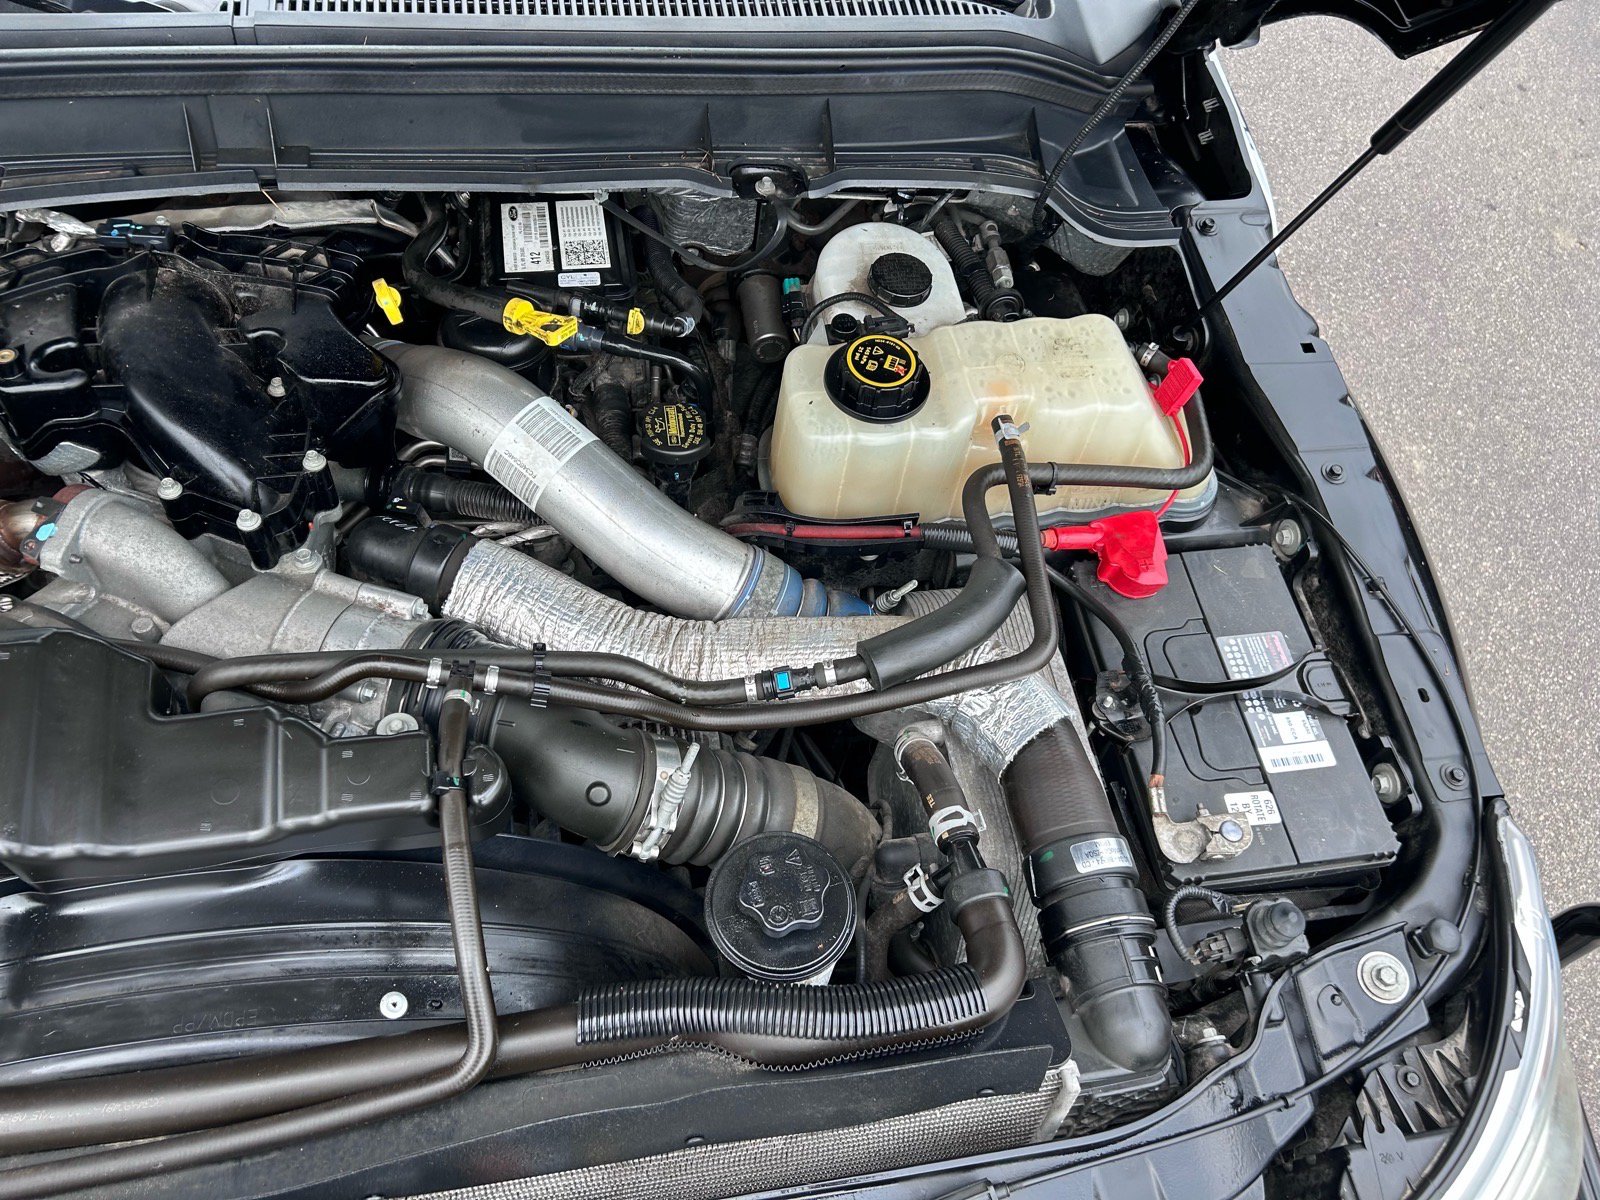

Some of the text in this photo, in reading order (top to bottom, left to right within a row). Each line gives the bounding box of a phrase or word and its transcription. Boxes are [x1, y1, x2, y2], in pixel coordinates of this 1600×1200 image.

[508, 206, 518, 221] Ford
[529, 251, 541, 265] 412
[644, 415, 652, 423] API
[665, 406, 677, 436] Motorcraft
[694, 415, 703, 423] API
[652, 437, 663, 446] SAE
[681, 434, 695, 449] Severe
[688, 422, 696, 433] Duty
[692, 435, 702, 445] SAE
[1290, 728, 1298, 740] CCA
[925, 793, 936, 809] TEE
[1250, 794, 1266, 822] ROTATE
[1264, 799, 1275, 815] 626
[1242, 803, 1252, 815] BY
